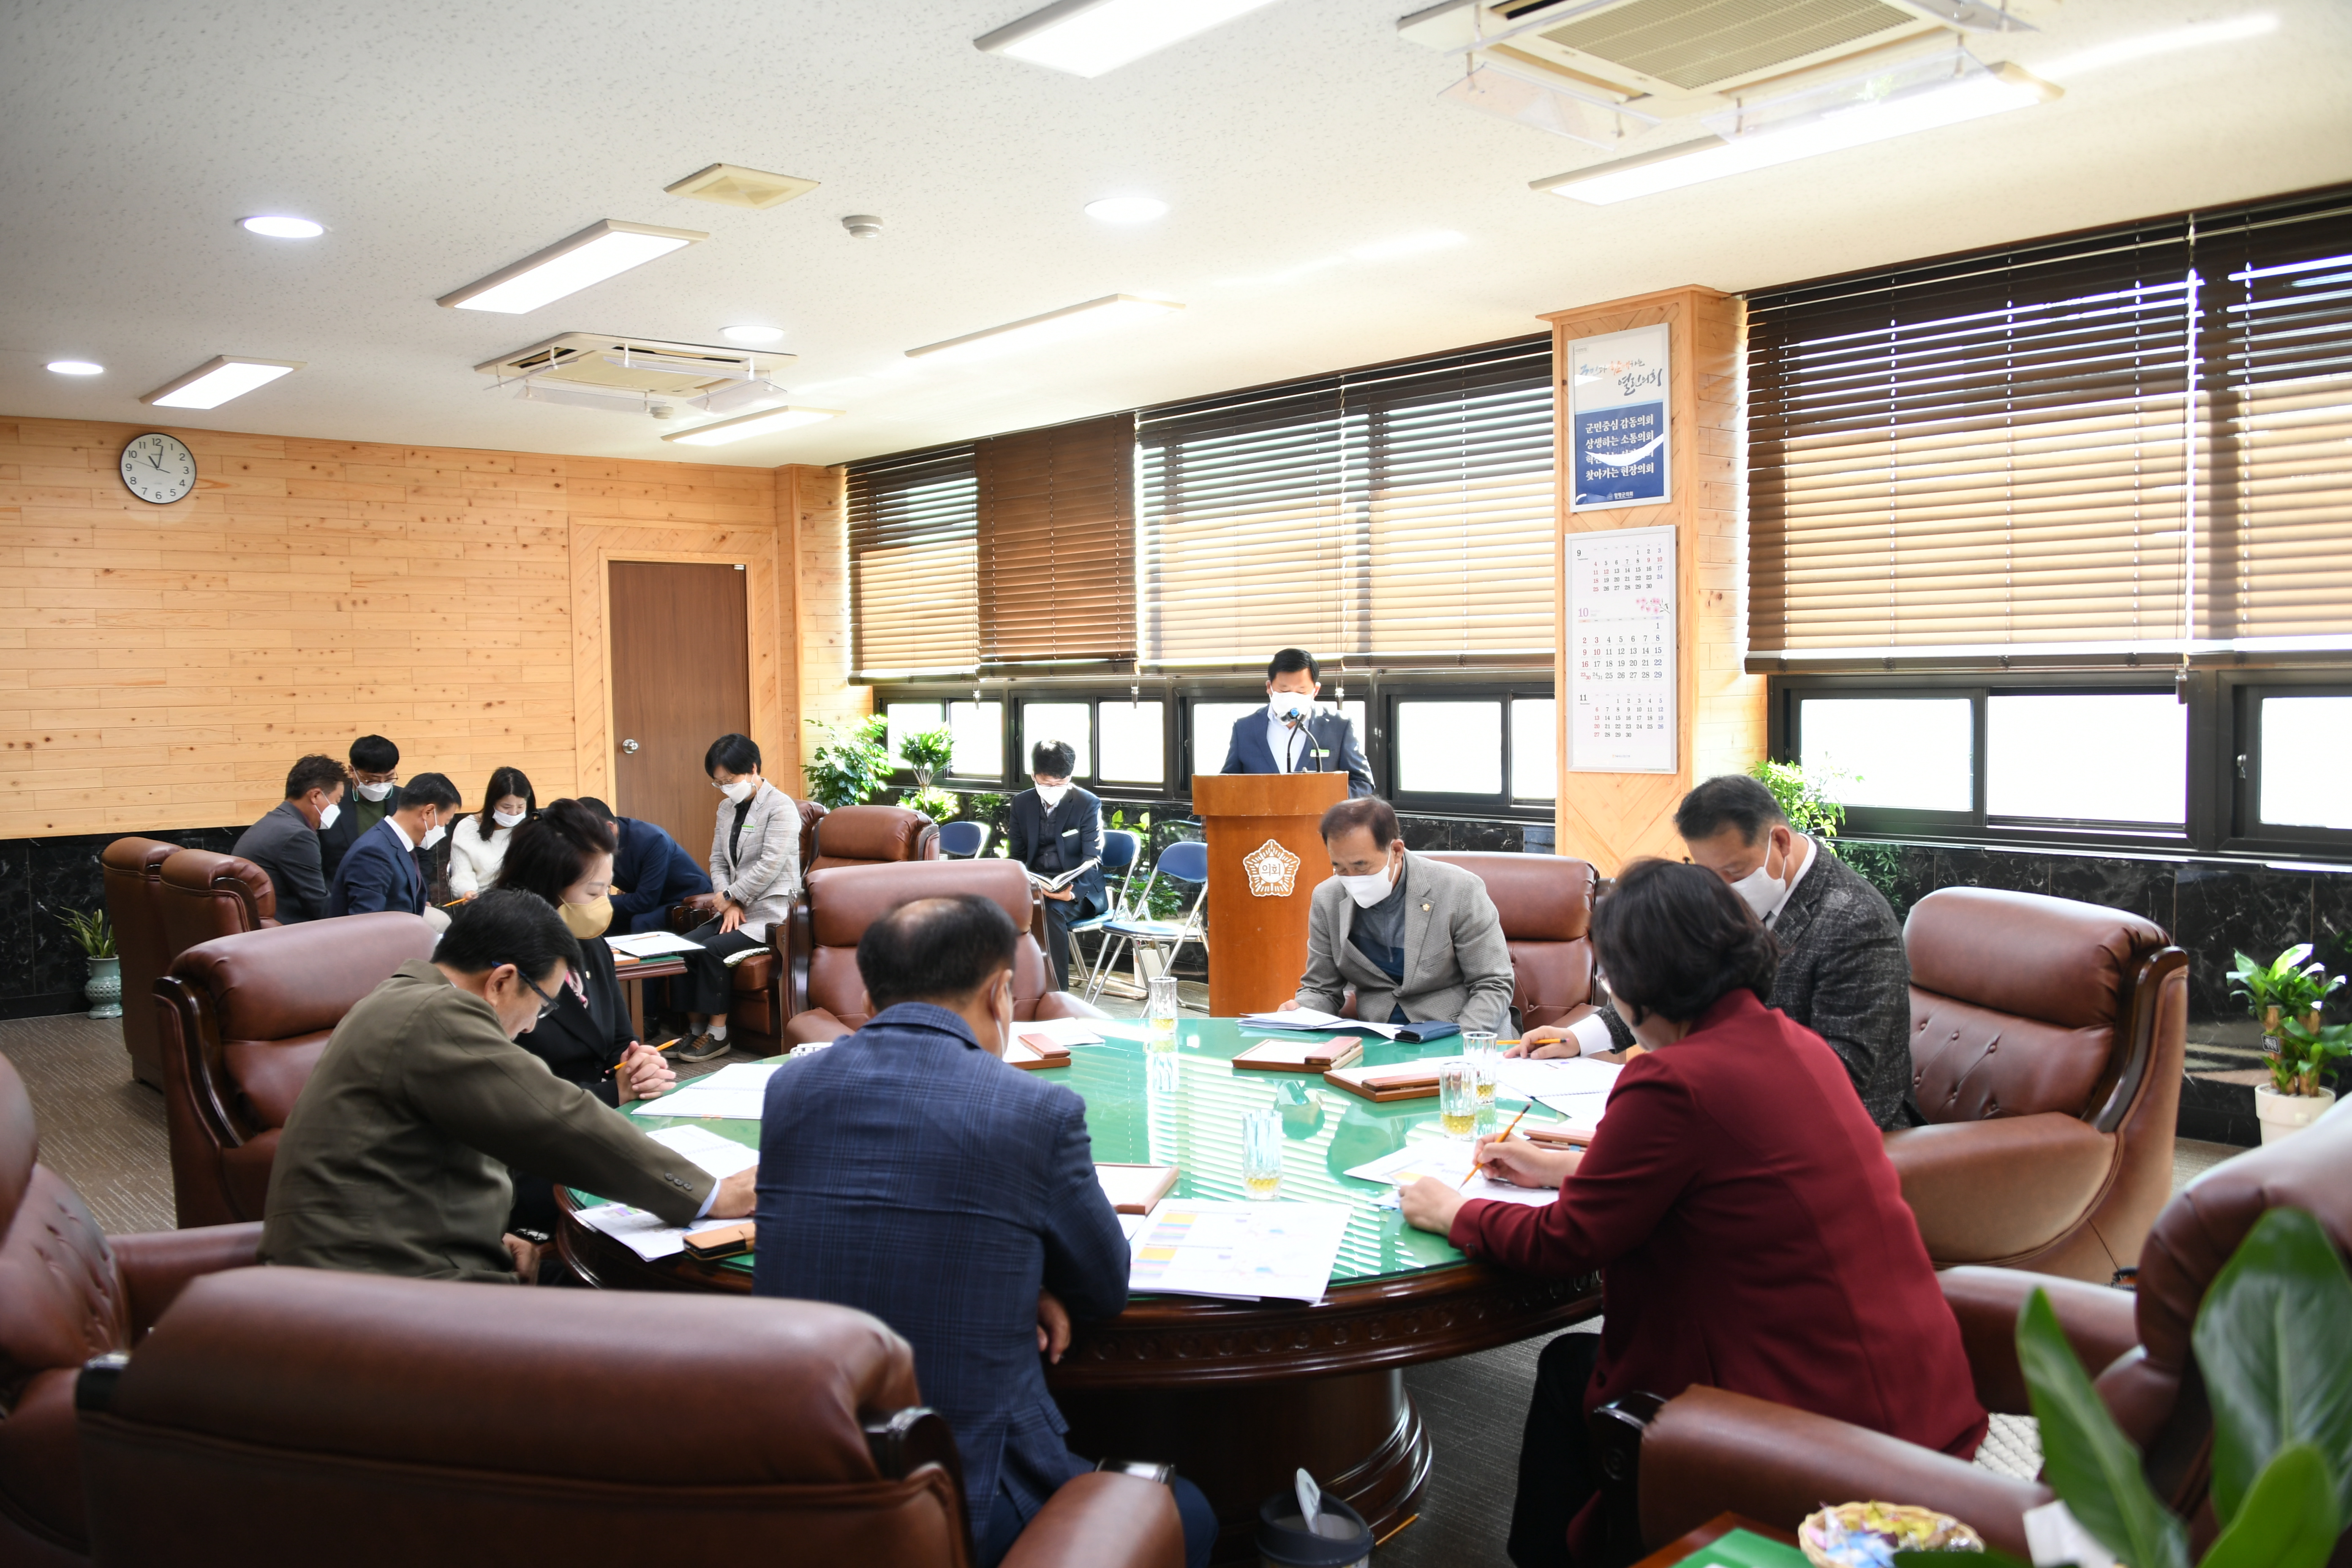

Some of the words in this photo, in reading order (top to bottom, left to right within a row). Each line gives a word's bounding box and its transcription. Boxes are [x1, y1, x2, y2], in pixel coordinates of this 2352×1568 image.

[1618, 368, 1662, 396] 열린의회
[1585, 419, 1618, 433] 군민중심
[1620, 414, 1653, 429] 감동의회
[1585, 436, 1619, 449] 상생하는
[1621, 430, 1654, 444] 소통의회
[128, 450, 137, 458] 10
[183, 466, 189, 474] 3
[1586, 468, 1619, 481] 찾아가는
[1620, 463, 1654, 476] 현장의회
[1579, 608, 1588, 617] 10
[1261, 863, 1281, 877] 의회
